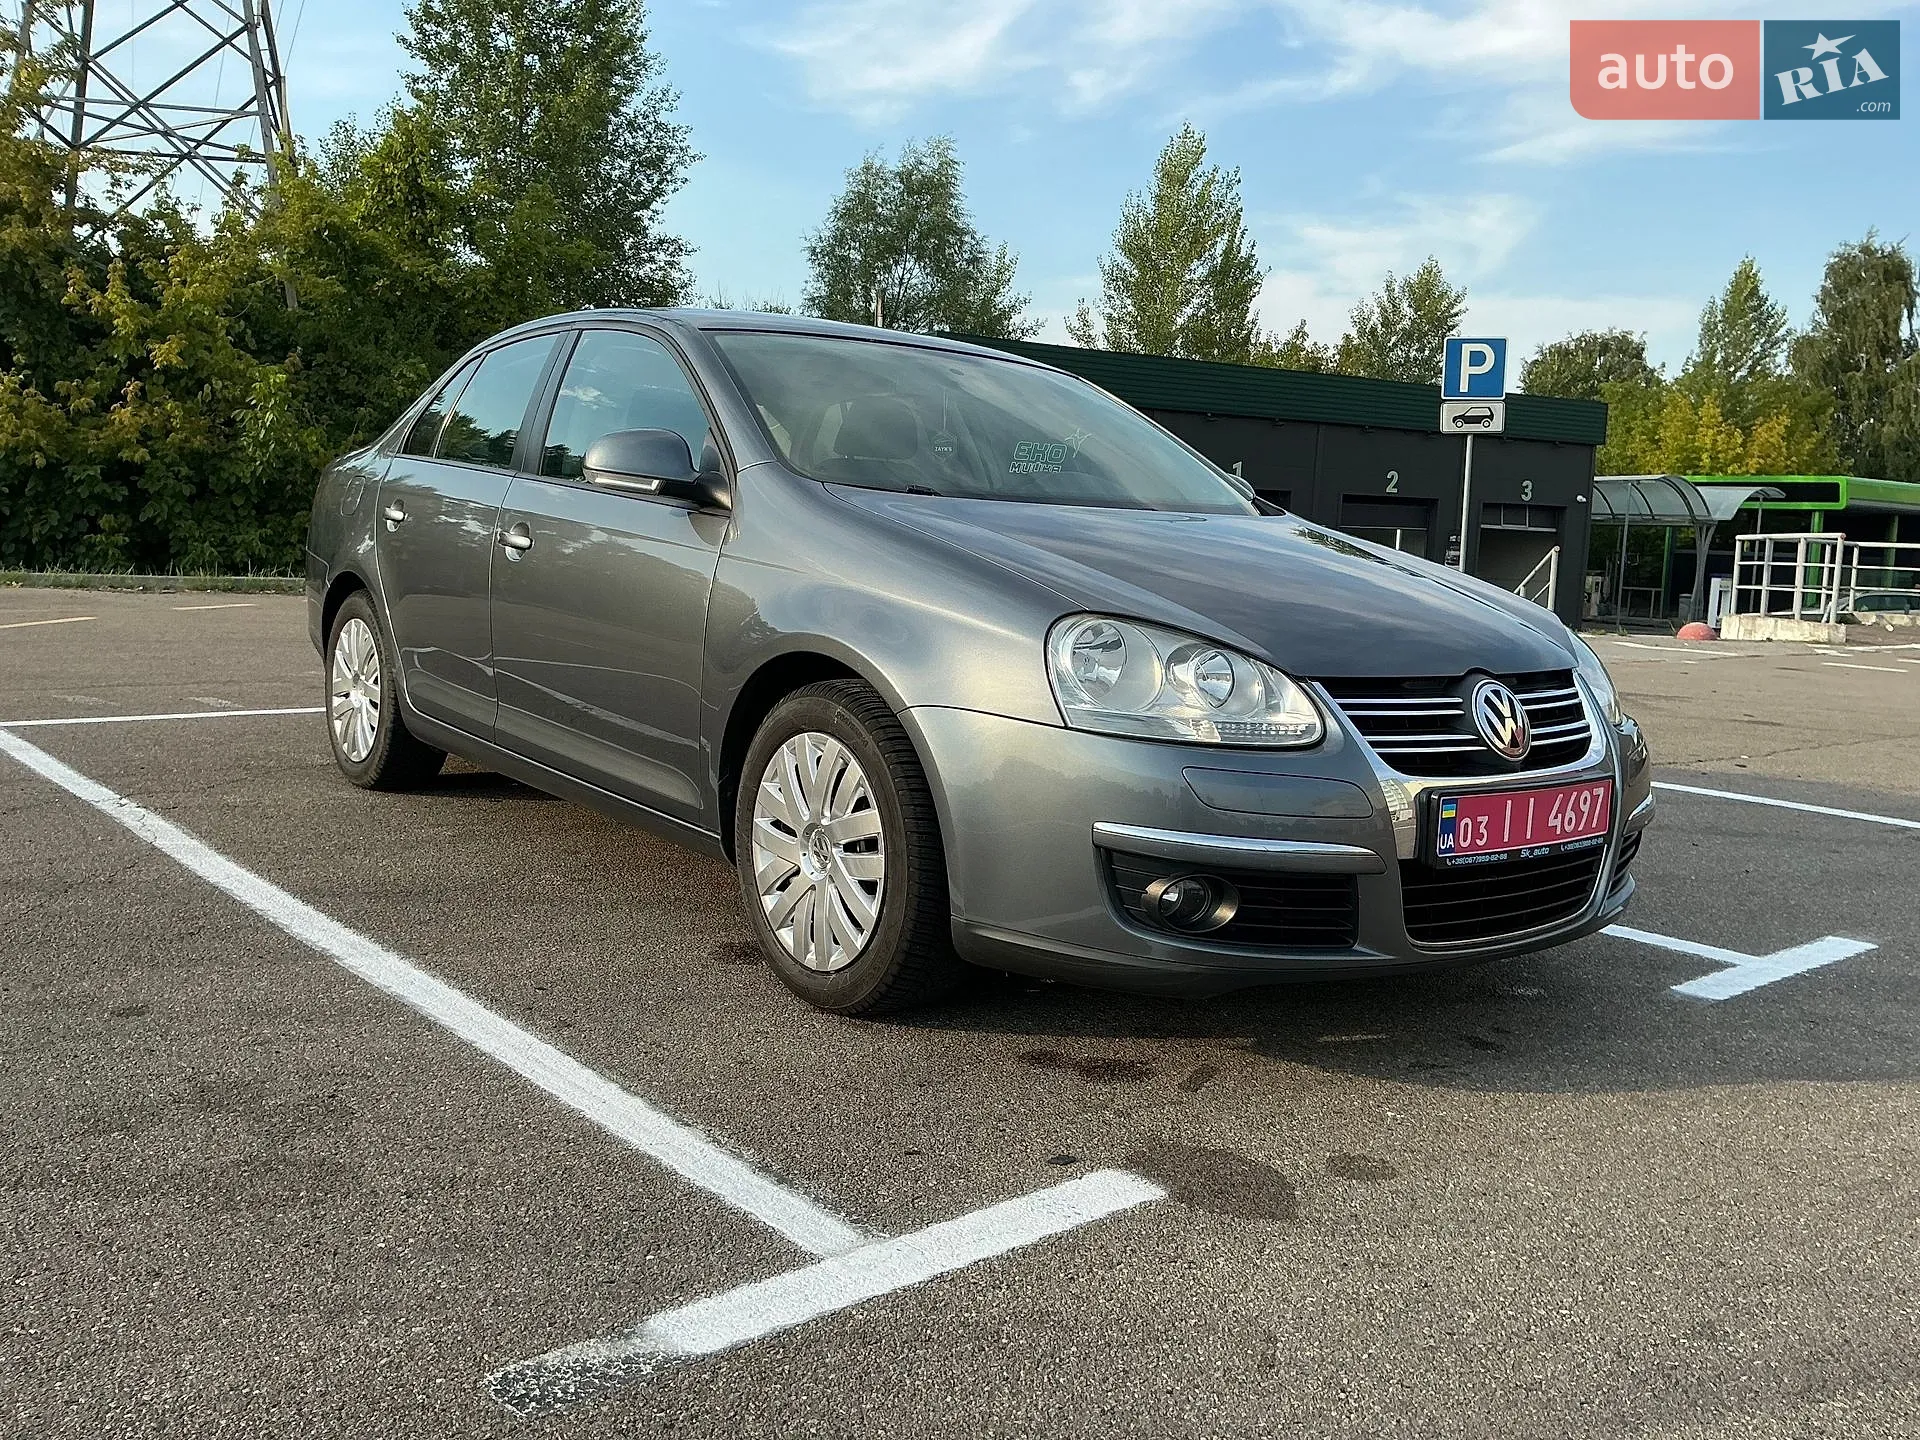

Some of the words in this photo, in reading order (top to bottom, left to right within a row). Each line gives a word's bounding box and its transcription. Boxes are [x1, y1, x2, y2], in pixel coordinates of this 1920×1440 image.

[1458, 343, 1496, 394] P
[1386, 470, 1399, 493] 2
[1520, 480, 1533, 502] 3
[1458, 815, 1489, 848] 03
[1548, 787, 1605, 835] 4697
[1439, 833, 1455, 850] UA
